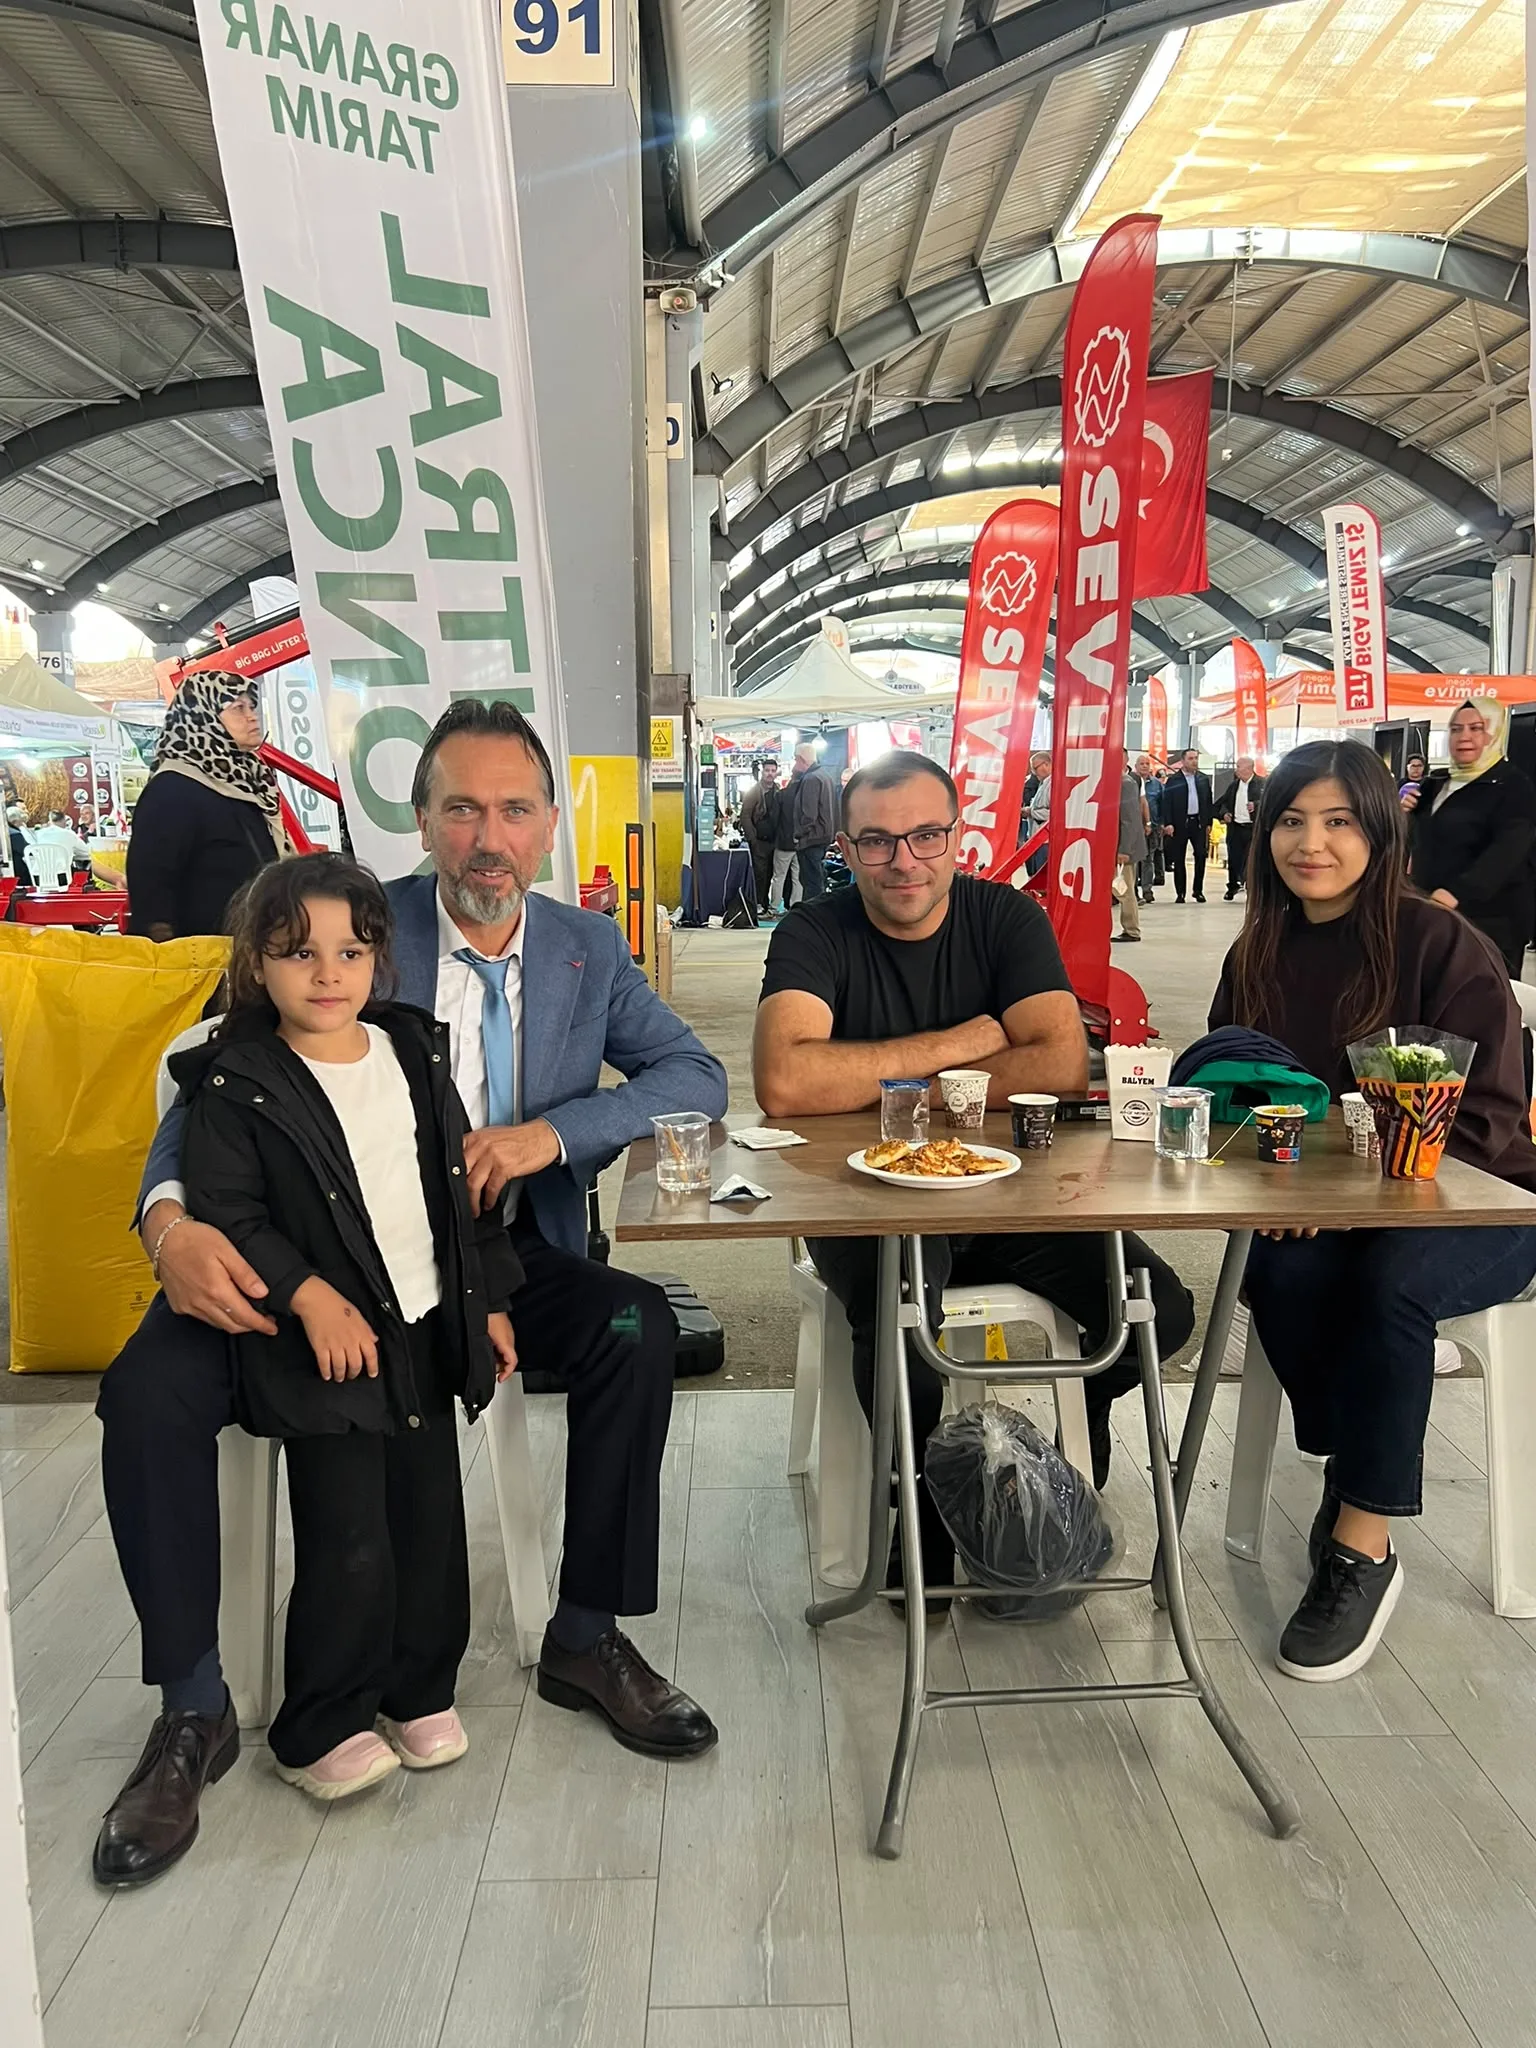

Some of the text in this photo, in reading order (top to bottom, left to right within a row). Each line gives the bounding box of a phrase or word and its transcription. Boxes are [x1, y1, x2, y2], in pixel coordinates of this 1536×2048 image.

[513, 0, 601, 55] 91
[251, 647, 271, 662] BAG
[41, 656, 61, 669] 76
[1424, 682, 1498, 699] evimde
[1121, 1076, 1155, 1086] BALYEM
